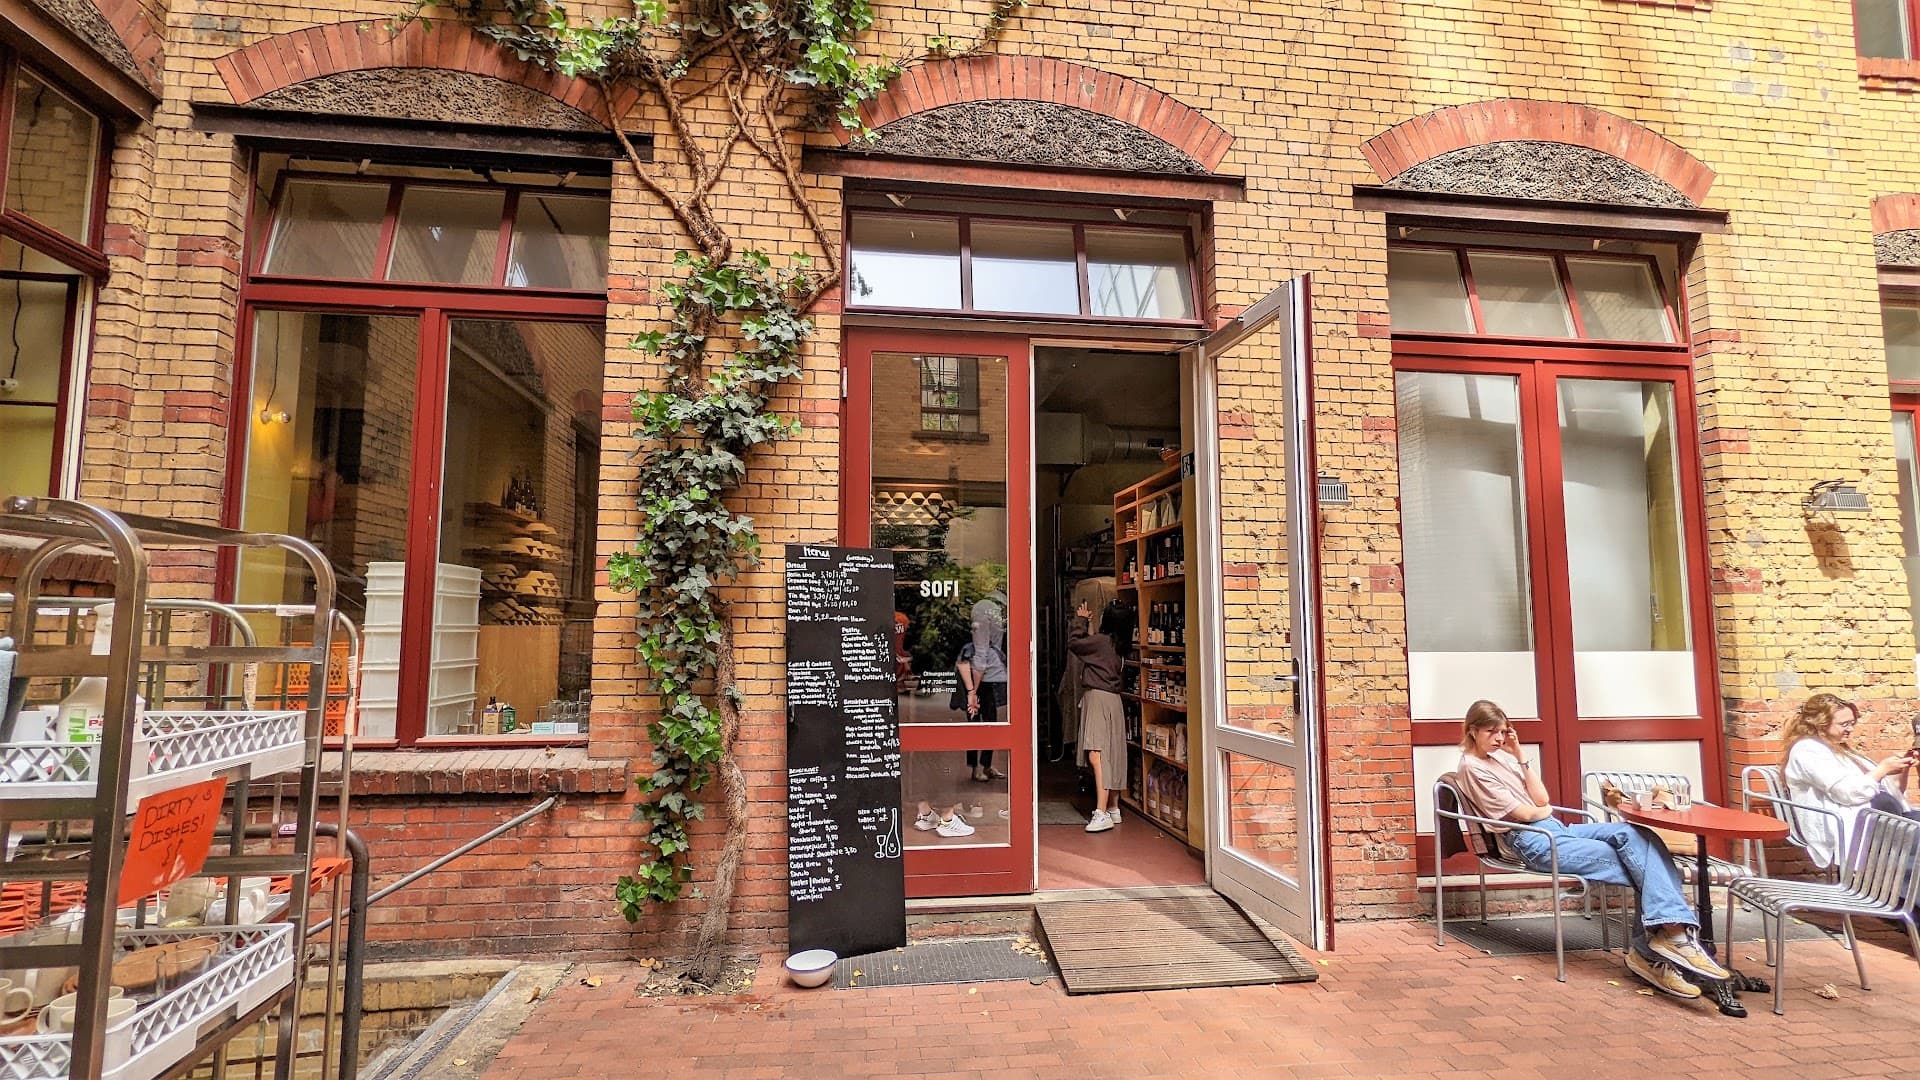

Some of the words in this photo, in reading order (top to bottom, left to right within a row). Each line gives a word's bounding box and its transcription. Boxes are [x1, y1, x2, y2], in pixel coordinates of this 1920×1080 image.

[803, 546, 830, 557] Menu
[920, 580, 959, 598] SOFI
[144, 794, 198, 829] DIRTY
[139, 814, 206, 852] DISHES!
